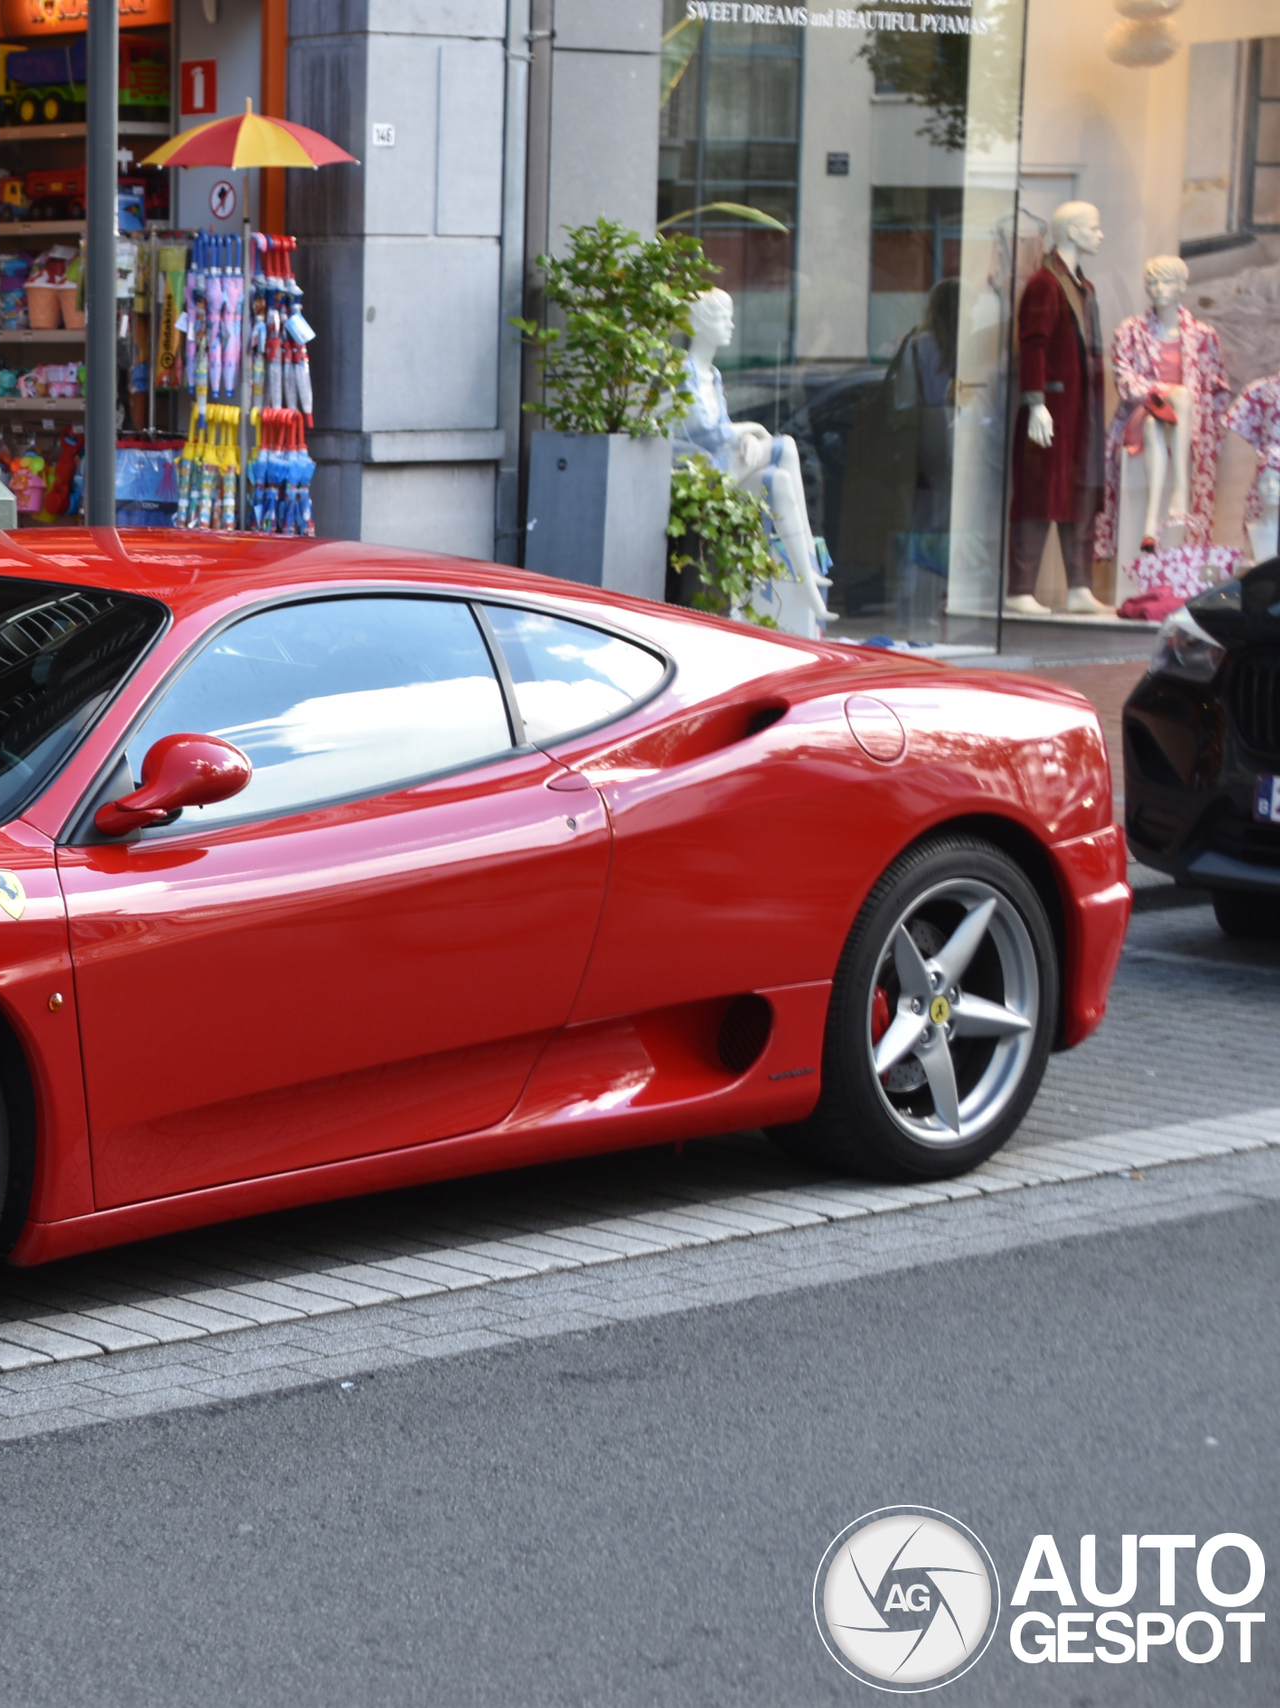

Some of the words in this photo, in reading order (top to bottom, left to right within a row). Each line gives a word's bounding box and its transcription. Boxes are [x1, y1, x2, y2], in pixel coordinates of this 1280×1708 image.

[686, 1, 741, 23] SWEET
[742, 3, 808, 27] DREAMS
[810, 8, 834, 28] and
[835, 8, 919, 33] BEAUTIFUL
[920, 13, 989, 36] PYJAMAS
